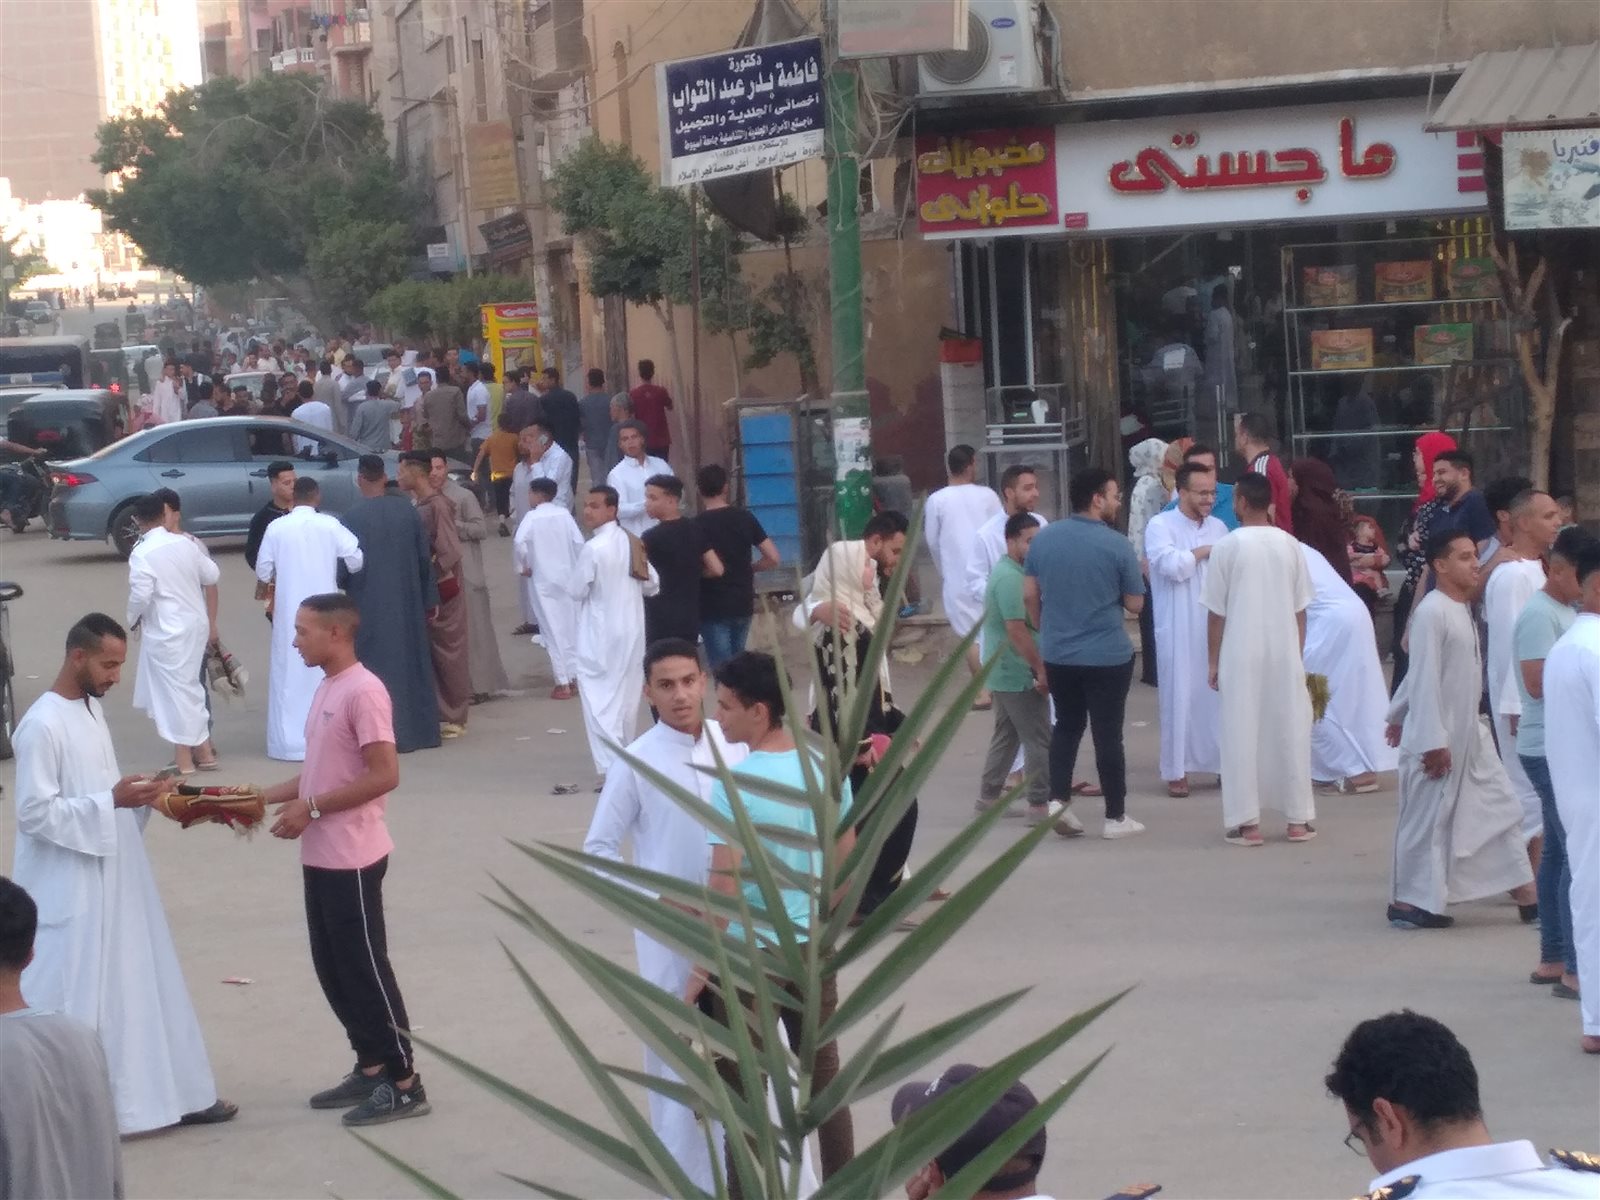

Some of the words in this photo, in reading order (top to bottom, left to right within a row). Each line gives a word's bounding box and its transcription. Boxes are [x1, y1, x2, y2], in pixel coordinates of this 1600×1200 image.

[728, 52, 762, 73] دكتورة
[775, 56, 819, 87] فاطمة
[672, 77, 716, 115] التواب
[719, 77, 745, 105] عبد
[747, 71, 774, 99] بدر
[675, 112, 727, 134] والتجميل
[727, 103, 772, 123] الجلدية
